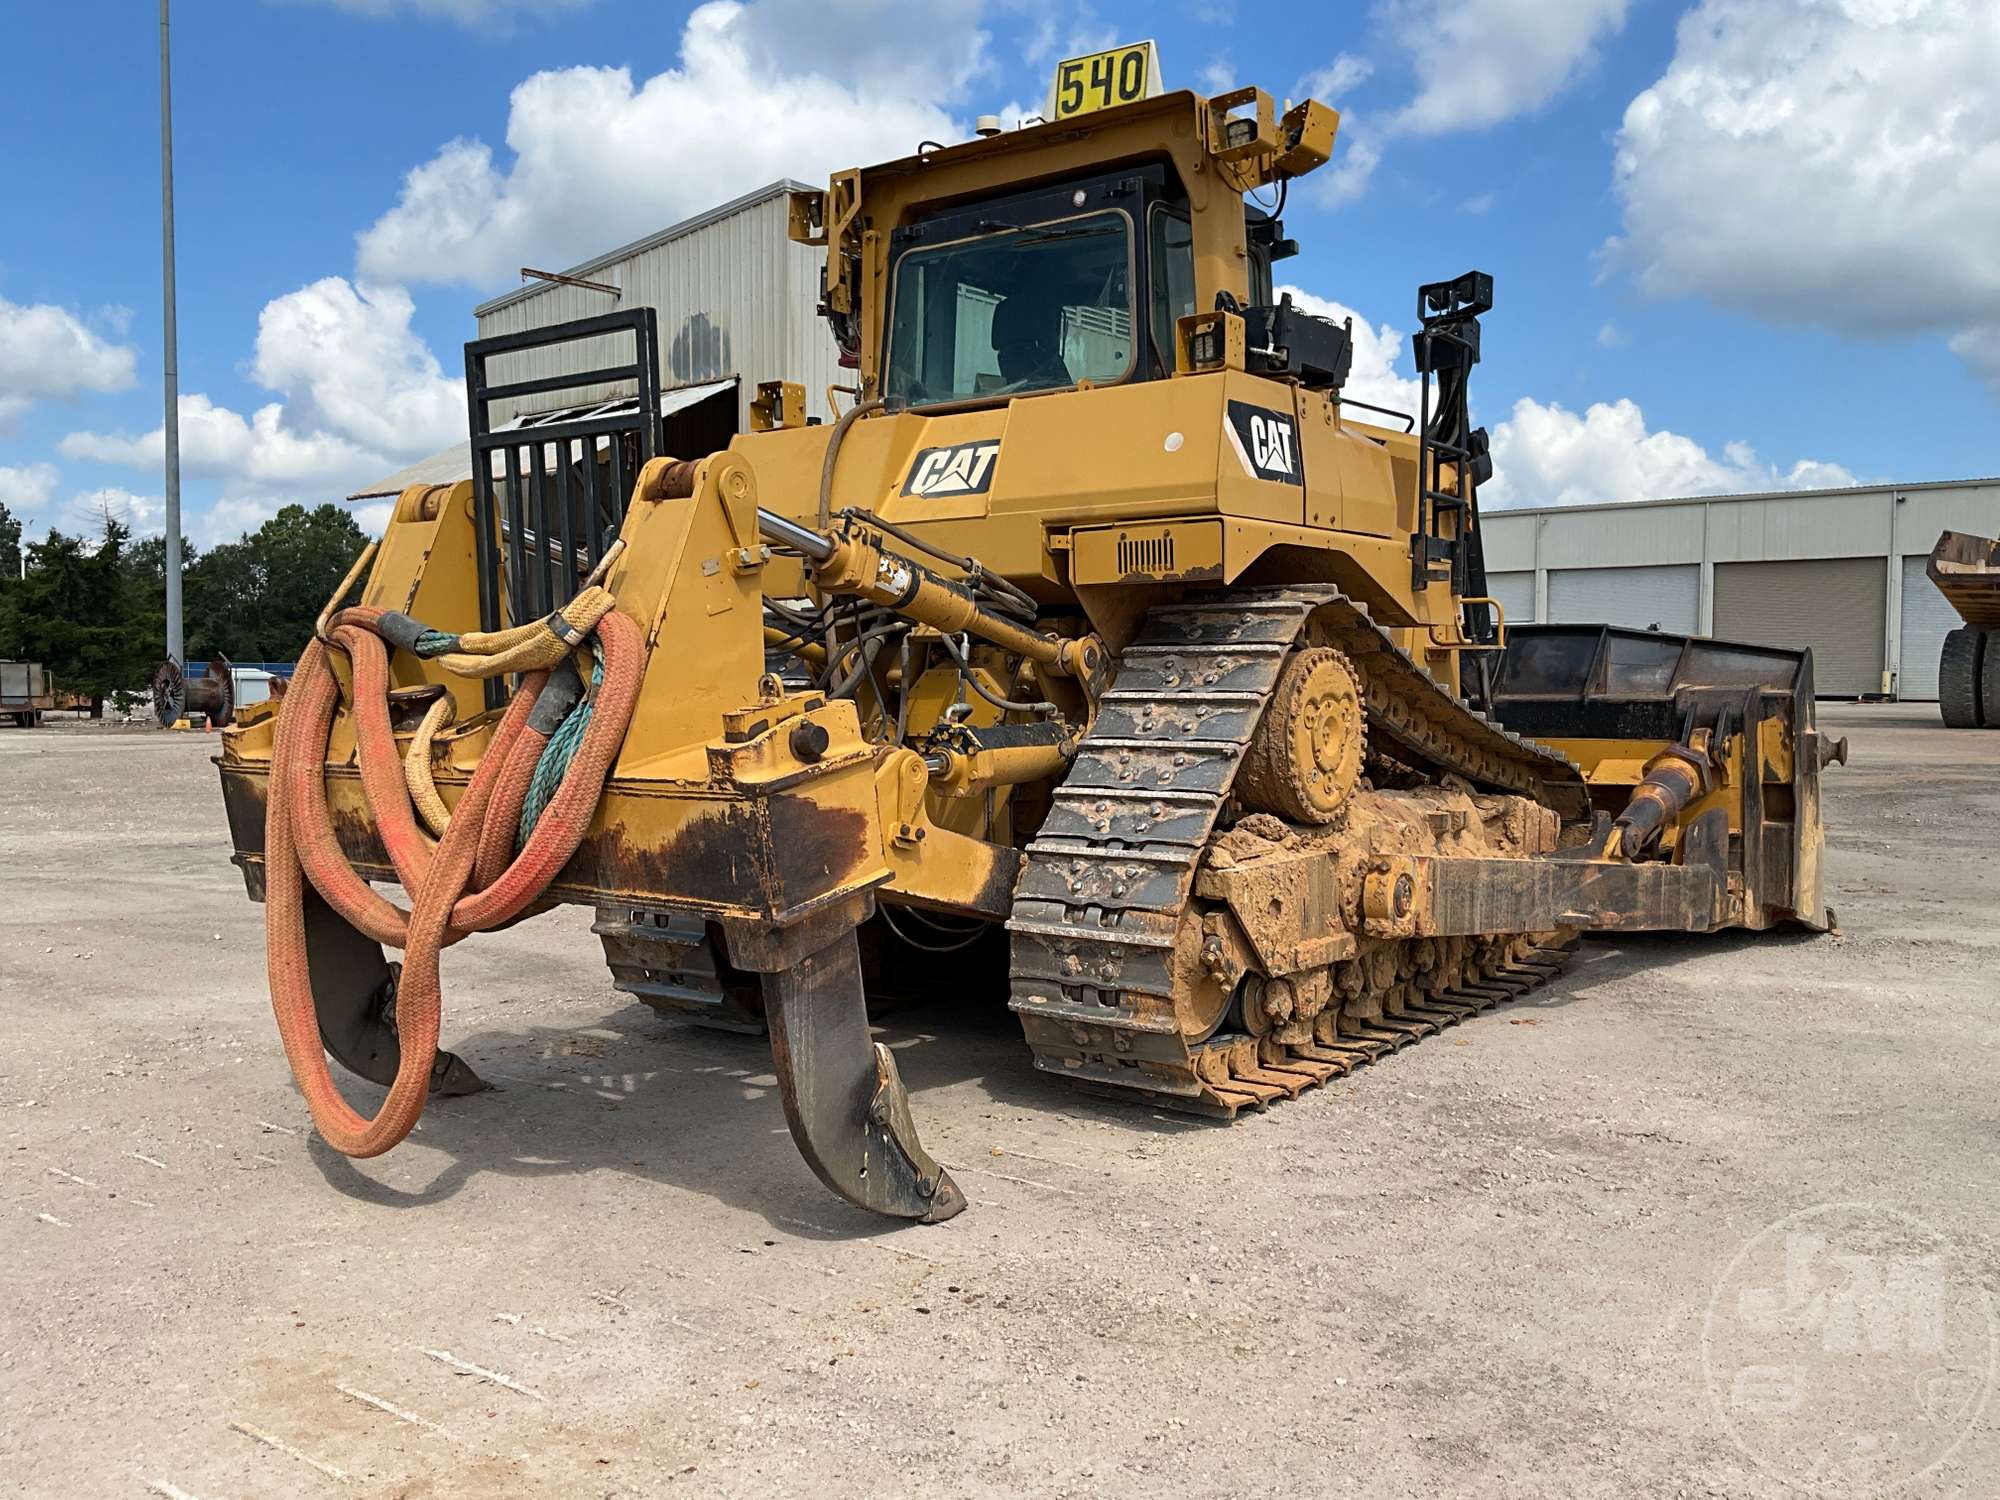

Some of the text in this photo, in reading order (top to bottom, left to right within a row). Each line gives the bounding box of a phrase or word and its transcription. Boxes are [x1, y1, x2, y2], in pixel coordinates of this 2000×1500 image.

[1062, 51, 1143, 114] 540
[910, 445, 1000, 496] CAT
[1251, 415, 1293, 474] CAT
